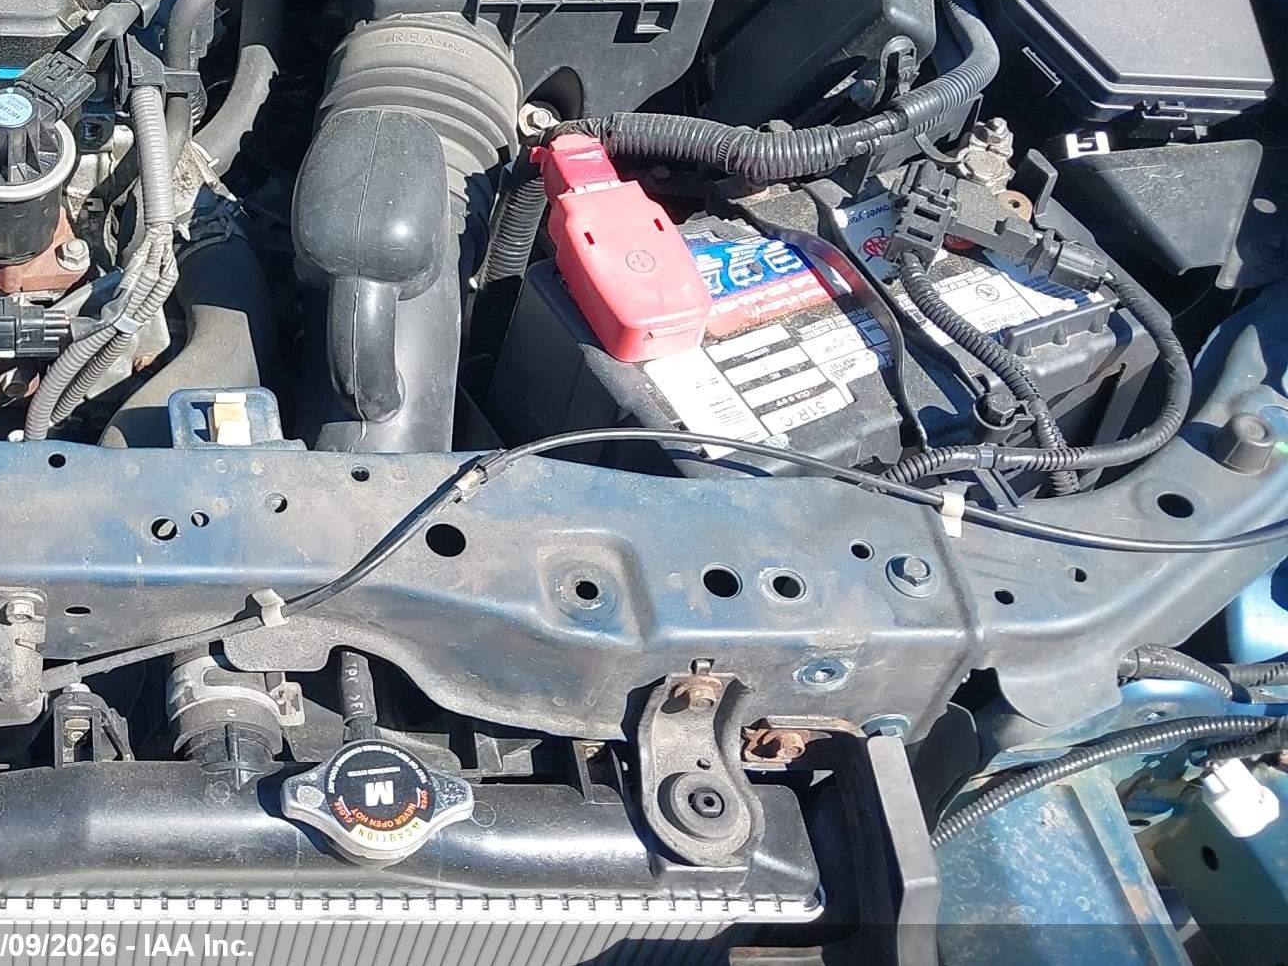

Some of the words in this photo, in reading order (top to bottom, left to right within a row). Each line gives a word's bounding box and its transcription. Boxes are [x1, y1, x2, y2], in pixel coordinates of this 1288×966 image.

[867, 204, 890, 219] ower
[365, 780, 394, 807] M
[419, 789, 429, 811] OPEN
[333, 801, 355, 824] CLOSE
[350, 808, 369, 824] HOT
[396, 802, 417, 826] NEVER
[369, 818, 395, 829] OPEN
[358, 826, 413, 842] CAUTION
